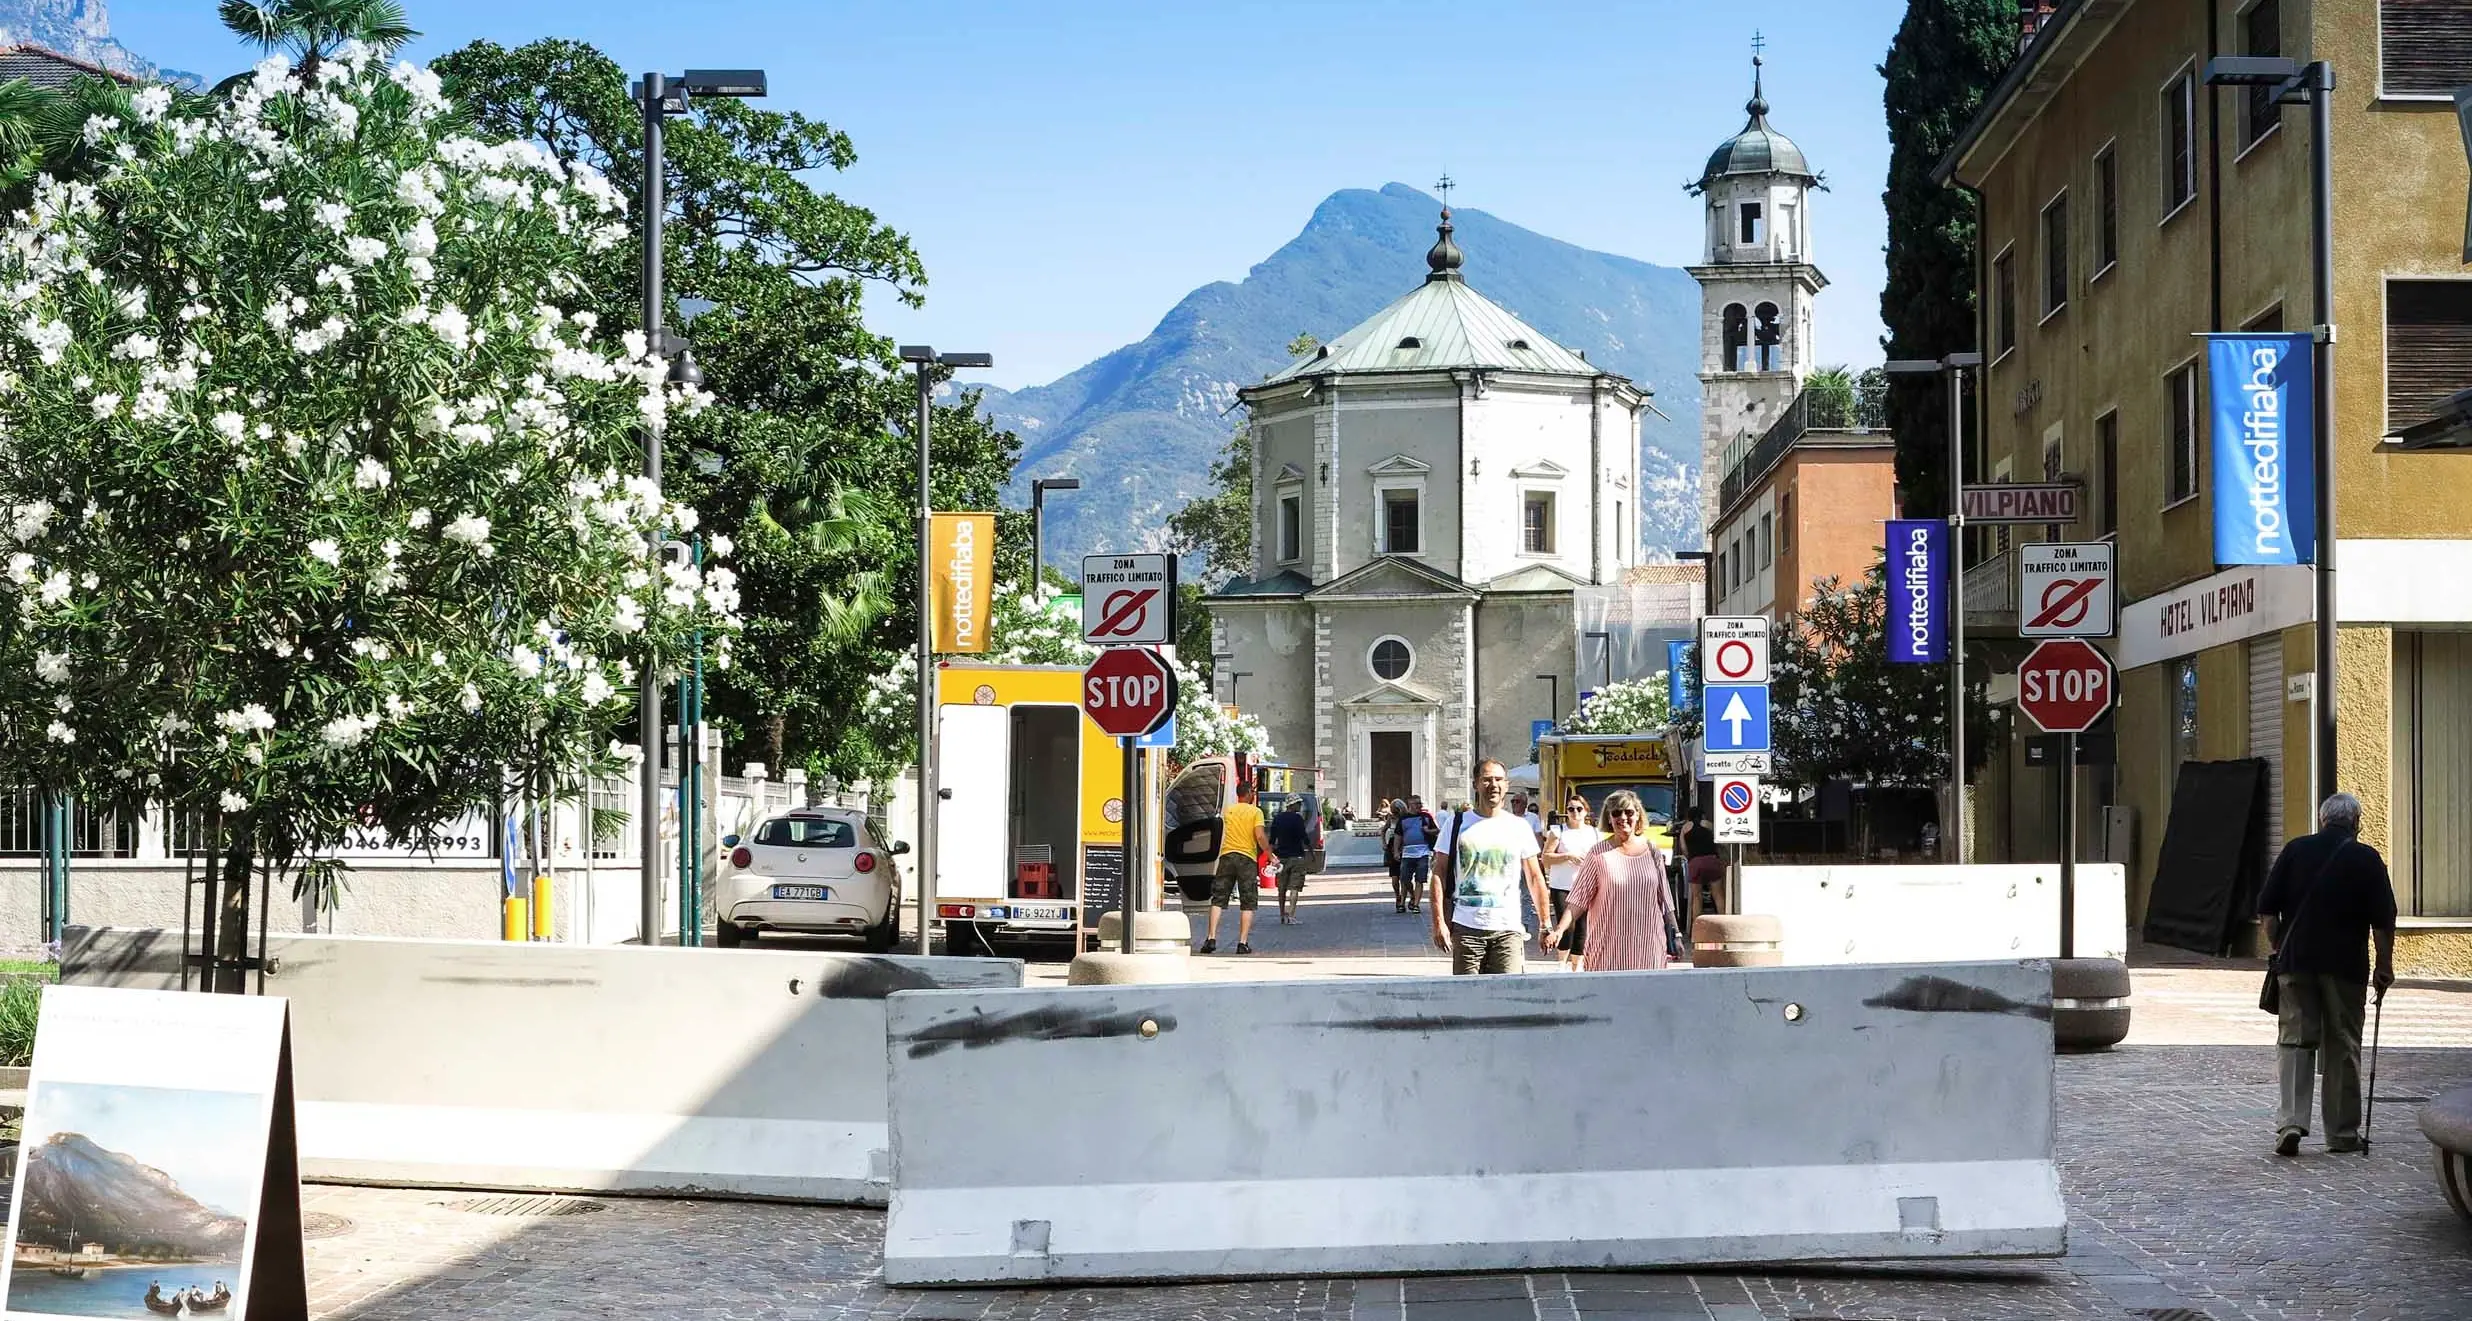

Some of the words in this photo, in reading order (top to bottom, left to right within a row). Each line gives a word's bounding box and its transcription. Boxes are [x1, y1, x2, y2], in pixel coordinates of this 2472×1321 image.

[2242, 347, 2281, 555] nottedifiaba
[1961, 490, 2074, 517] VILPIANO
[2054, 548, 2078, 559] ZONA
[1113, 559, 1136, 569] ZONA
[2024, 562, 2066, 573] TRAFFICO
[2070, 561, 2108, 572] LIMITATO
[950, 520, 974, 647] nottedifiaba
[1086, 573, 1125, 583] TRAFFICO
[1128, 571, 1163, 582] LIMITATO
[1905, 528, 1929, 656] nottedifiaba
[2160, 598, 2194, 639] HOTEL
[2201, 578, 2254, 627] VILPIANO
[1727, 621, 1744, 629] ZONA
[1706, 631, 1737, 639] TRAFFICO
[1087, 675, 1160, 708] STOP
[2024, 668, 2104, 702] STOP
[1706, 760, 1732, 768] eccetto
